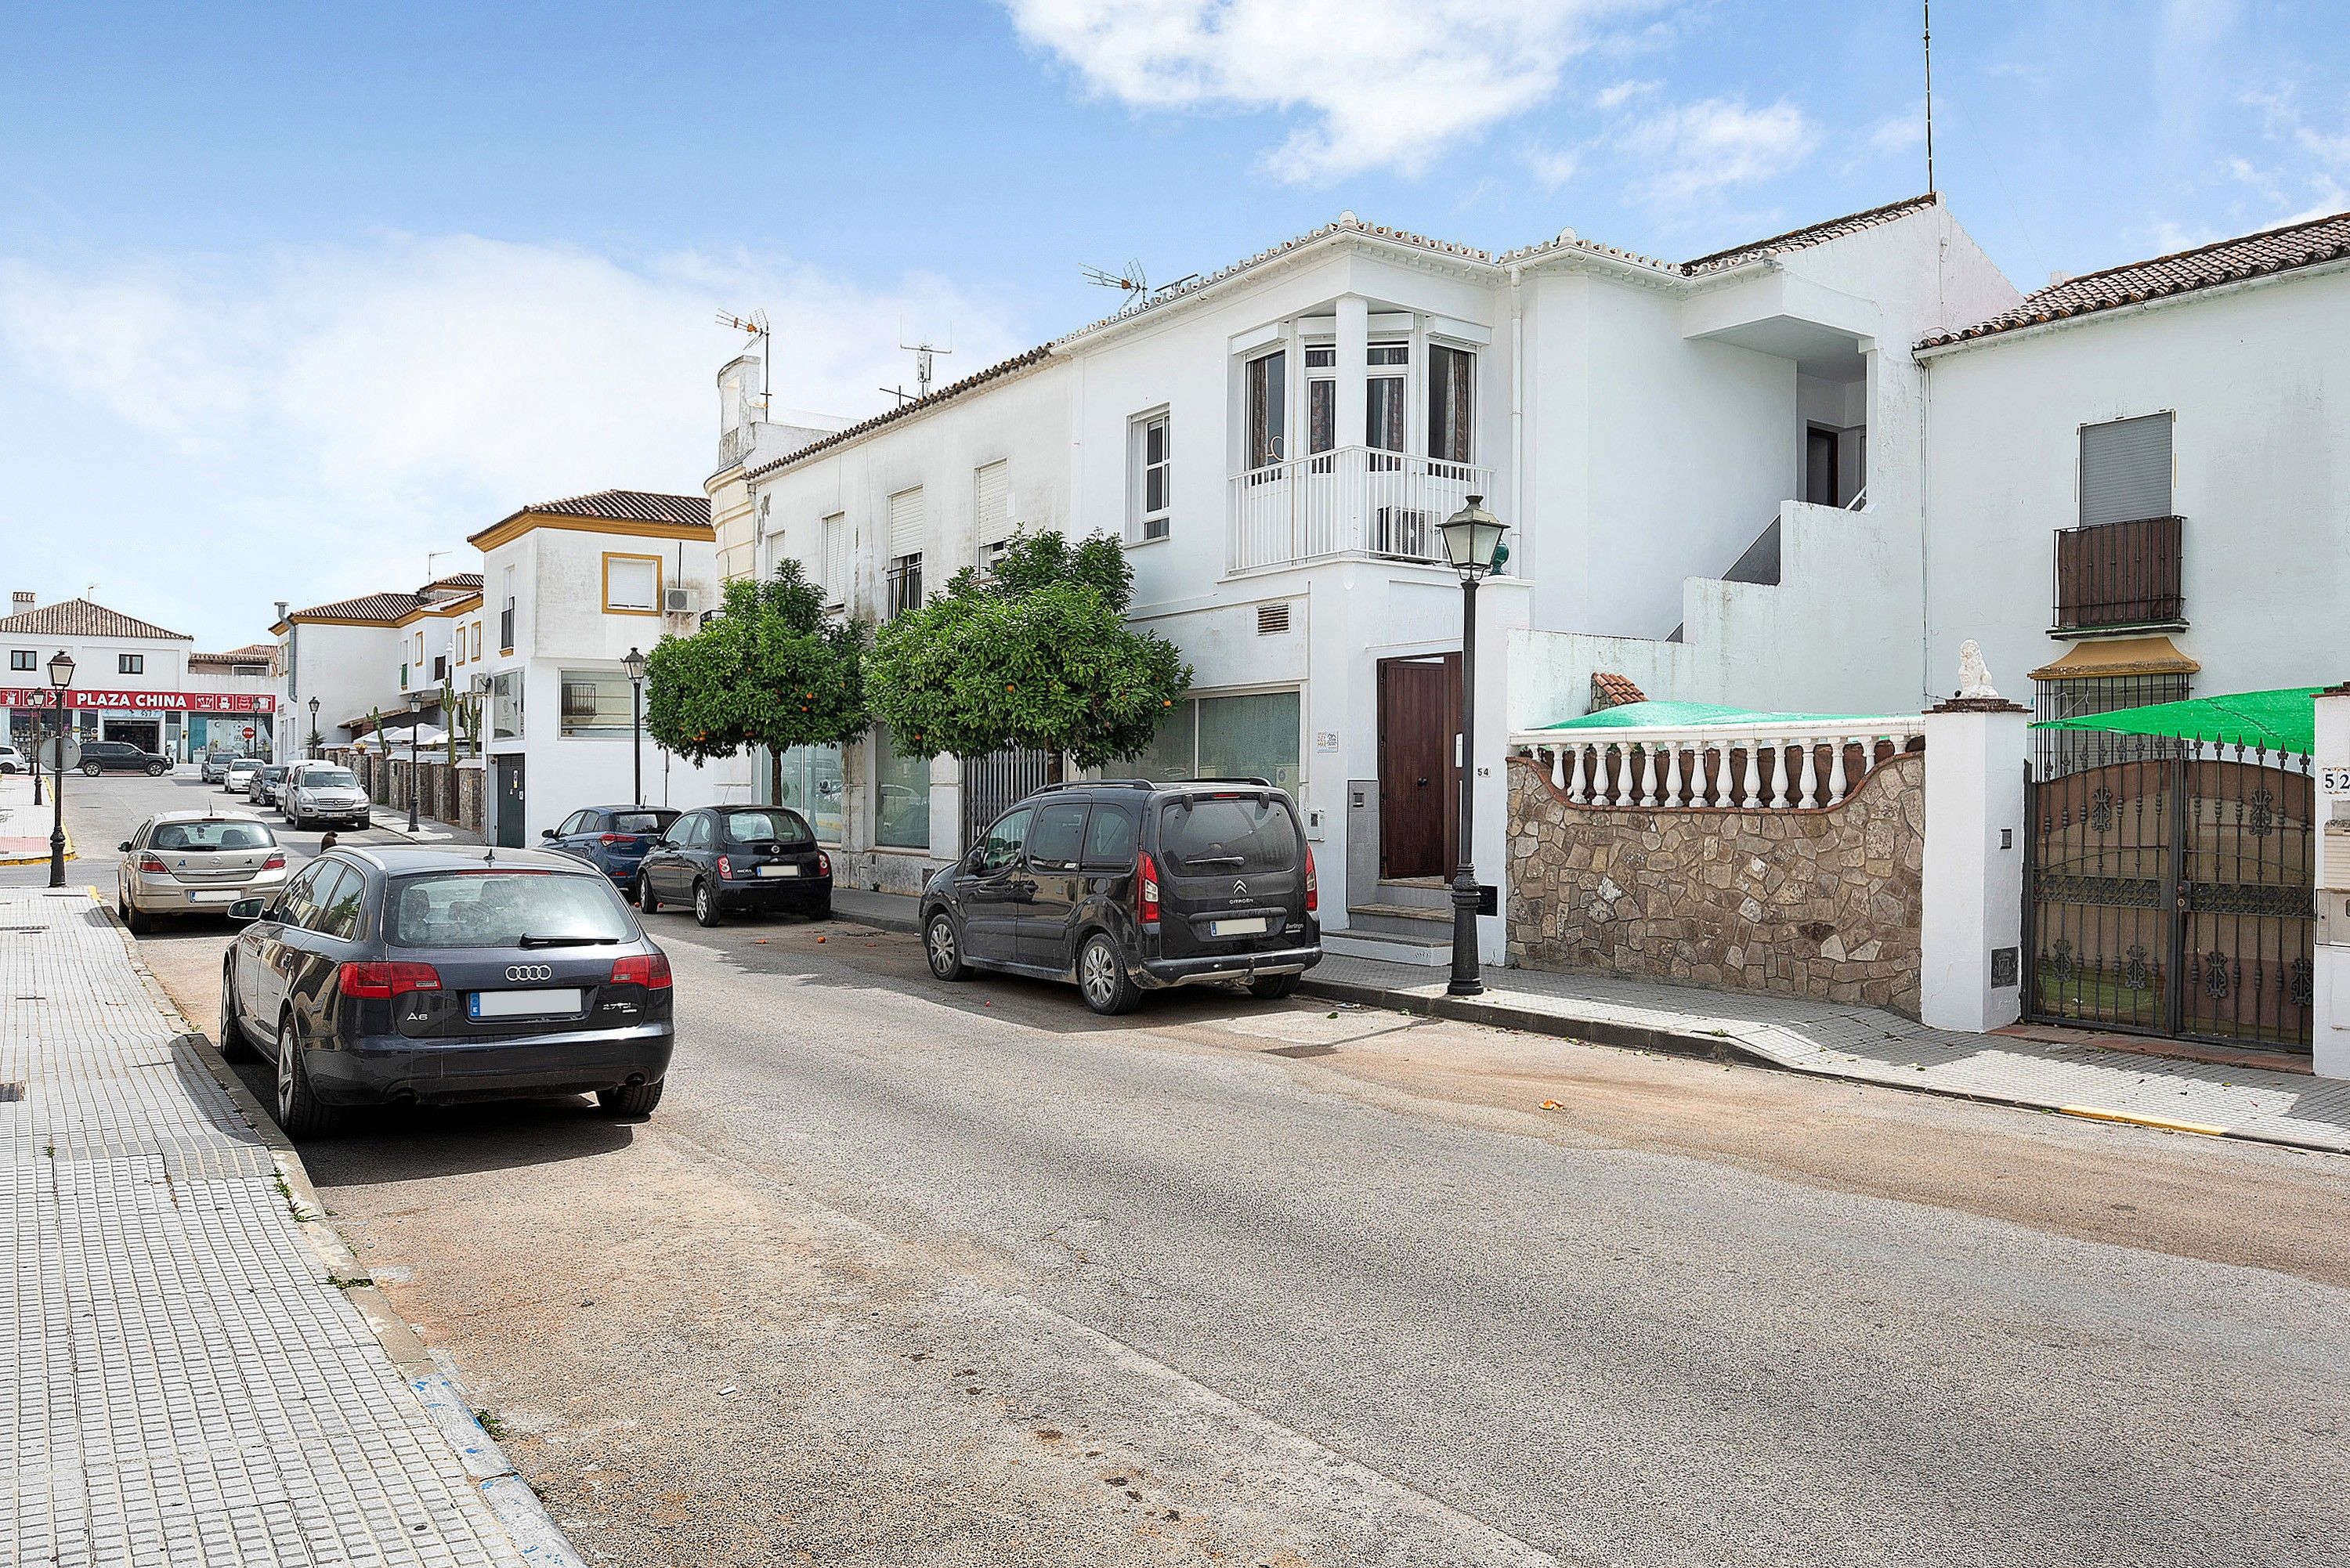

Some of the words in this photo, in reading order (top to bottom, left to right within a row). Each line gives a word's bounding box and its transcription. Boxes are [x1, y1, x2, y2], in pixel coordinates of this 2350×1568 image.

[77, 693, 131, 706] PLAZA
[135, 694, 186, 707] CHINA
[1477, 768, 1489, 776] 54
[2325, 773, 2350, 789] 52
[407, 1012, 428, 1021] A6
